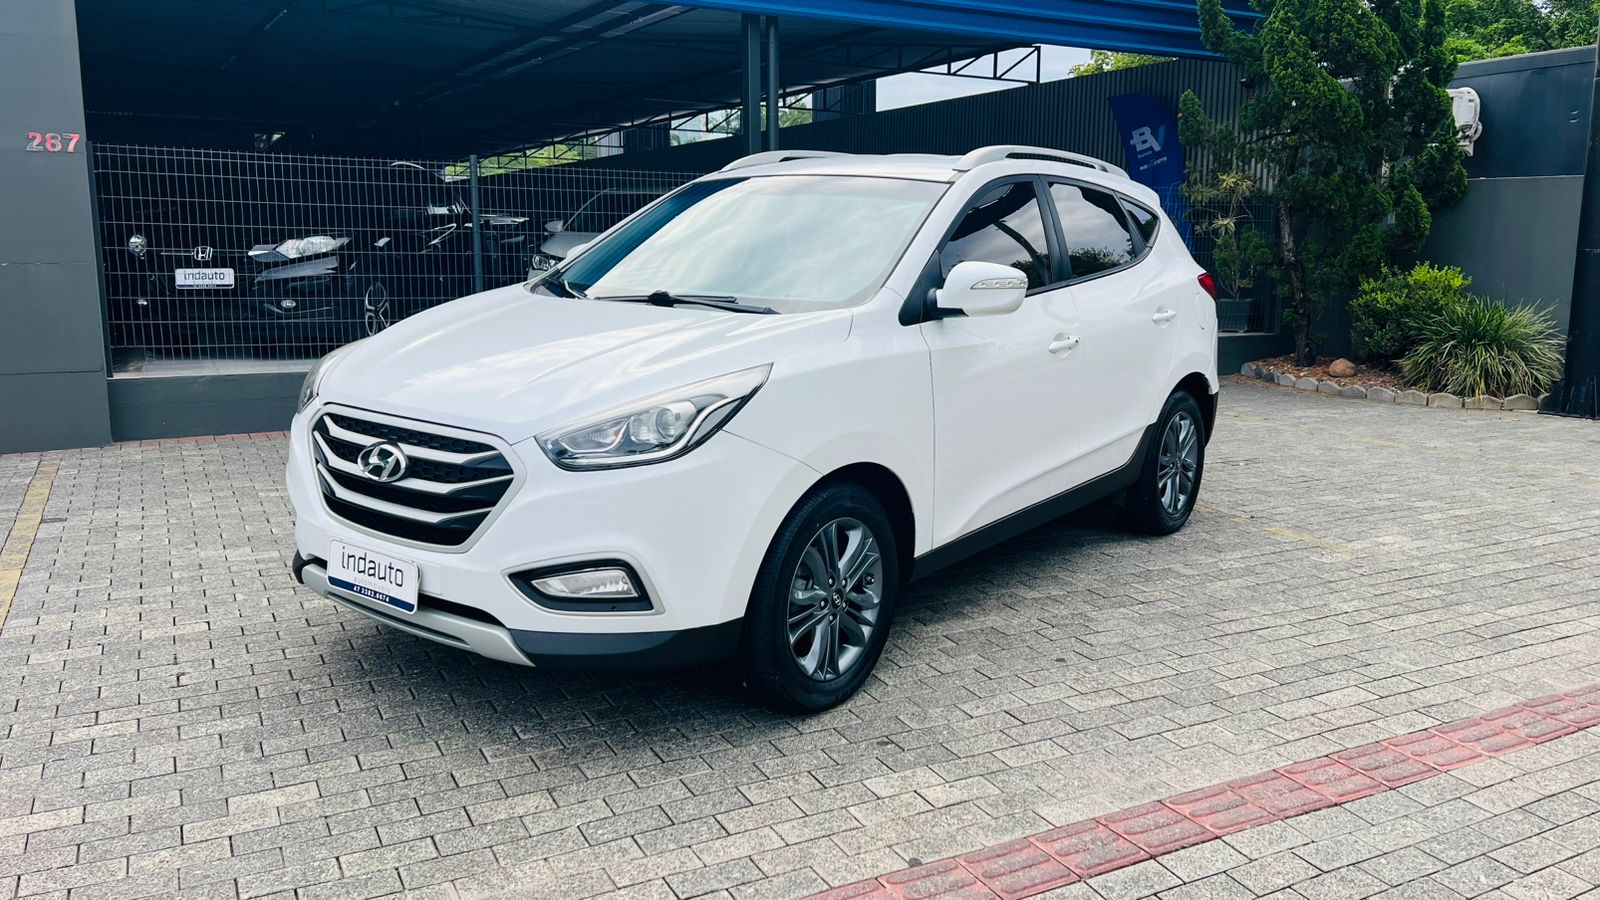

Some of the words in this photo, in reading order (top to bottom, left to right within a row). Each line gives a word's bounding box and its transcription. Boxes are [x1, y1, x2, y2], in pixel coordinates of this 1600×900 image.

[25, 131, 80, 153] 287
[1130, 125, 1166, 152] BV
[183, 270, 225, 281] indauto
[341, 545, 404, 588] indauto
